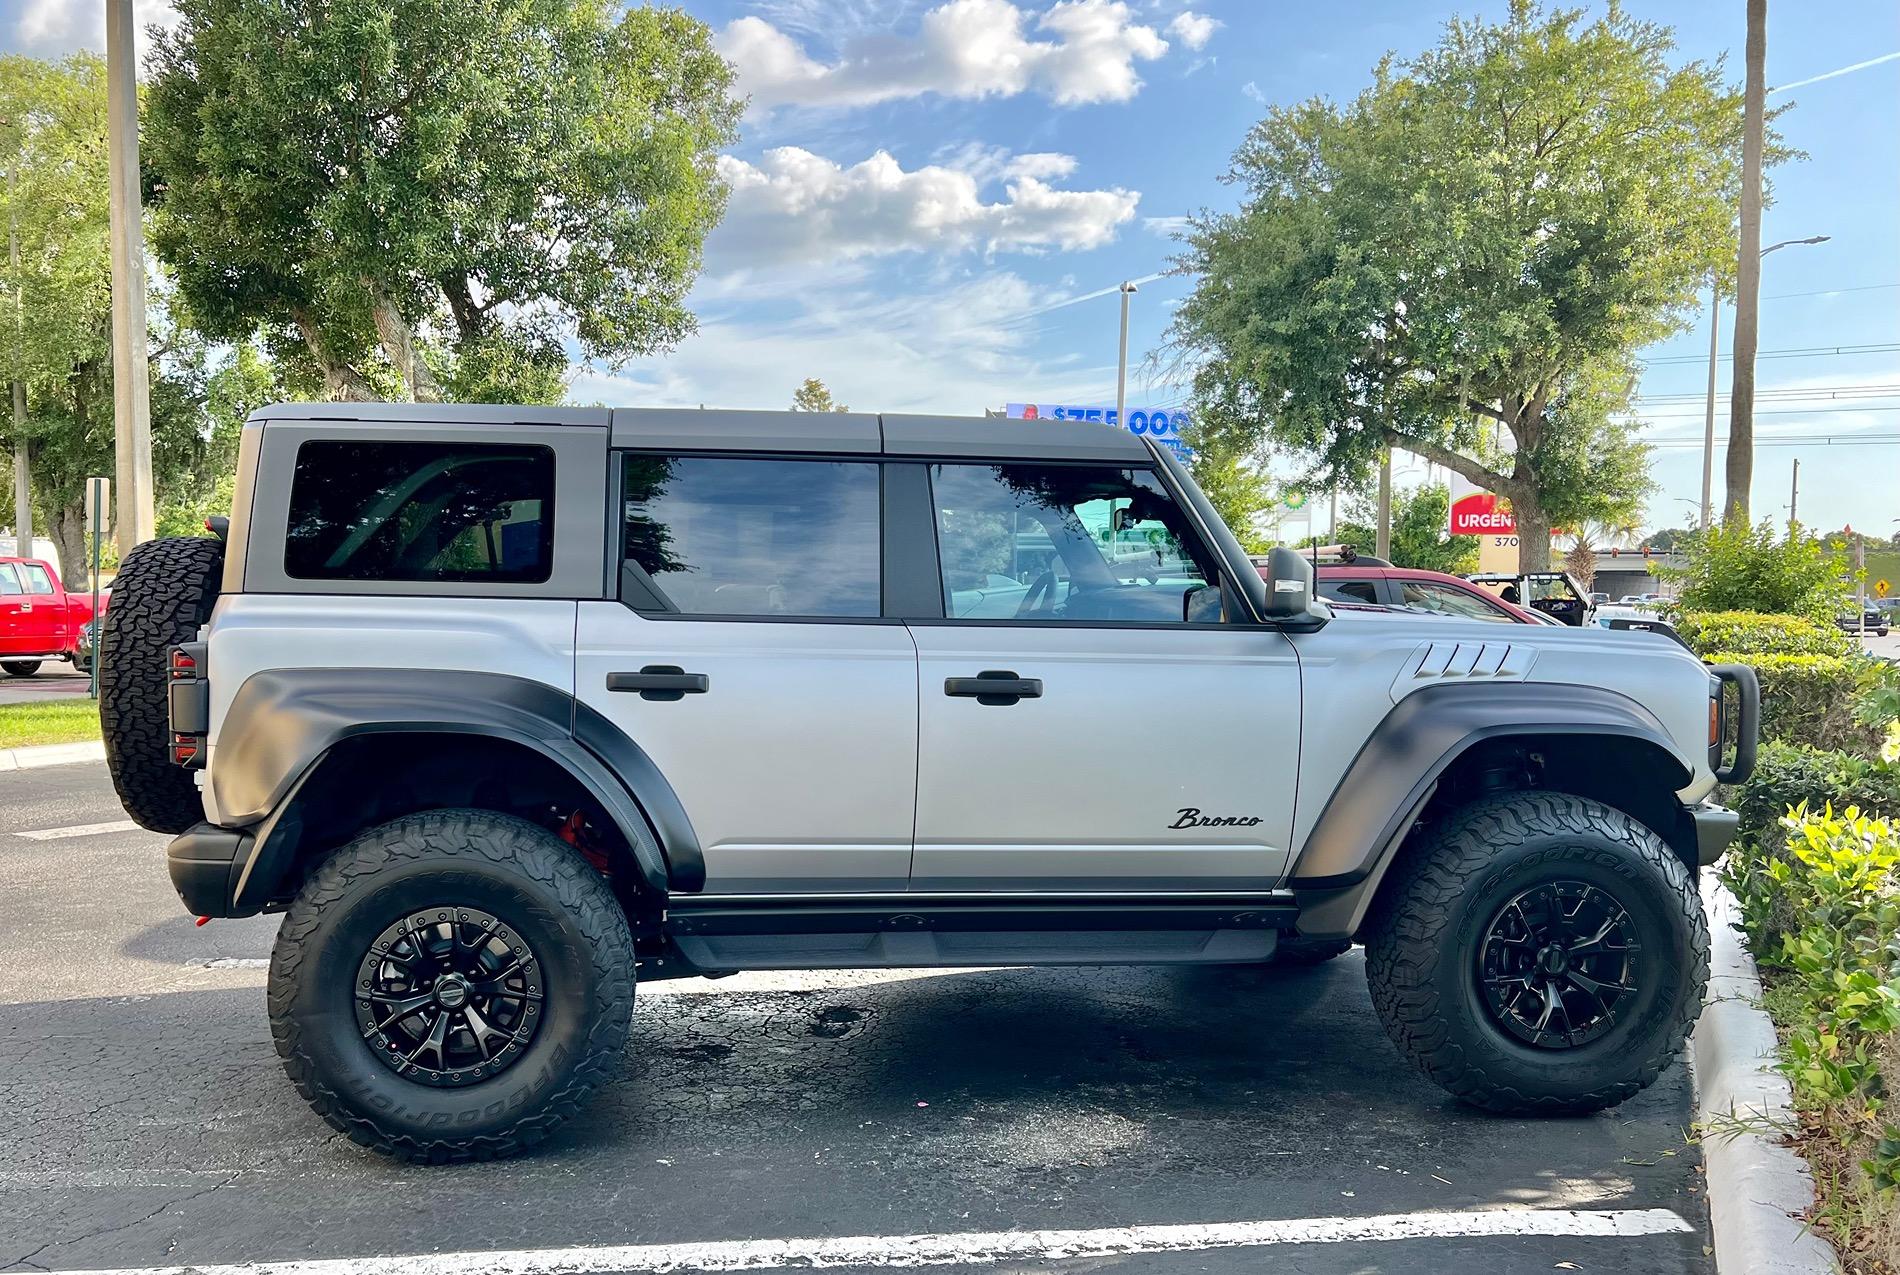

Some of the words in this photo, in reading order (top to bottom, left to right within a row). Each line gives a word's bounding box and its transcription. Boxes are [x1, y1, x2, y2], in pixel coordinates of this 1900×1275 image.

[1054, 407, 1190, 436] $755000
[1458, 513, 1517, 529] URGEN
[1168, 808, 1263, 829] Bronco
